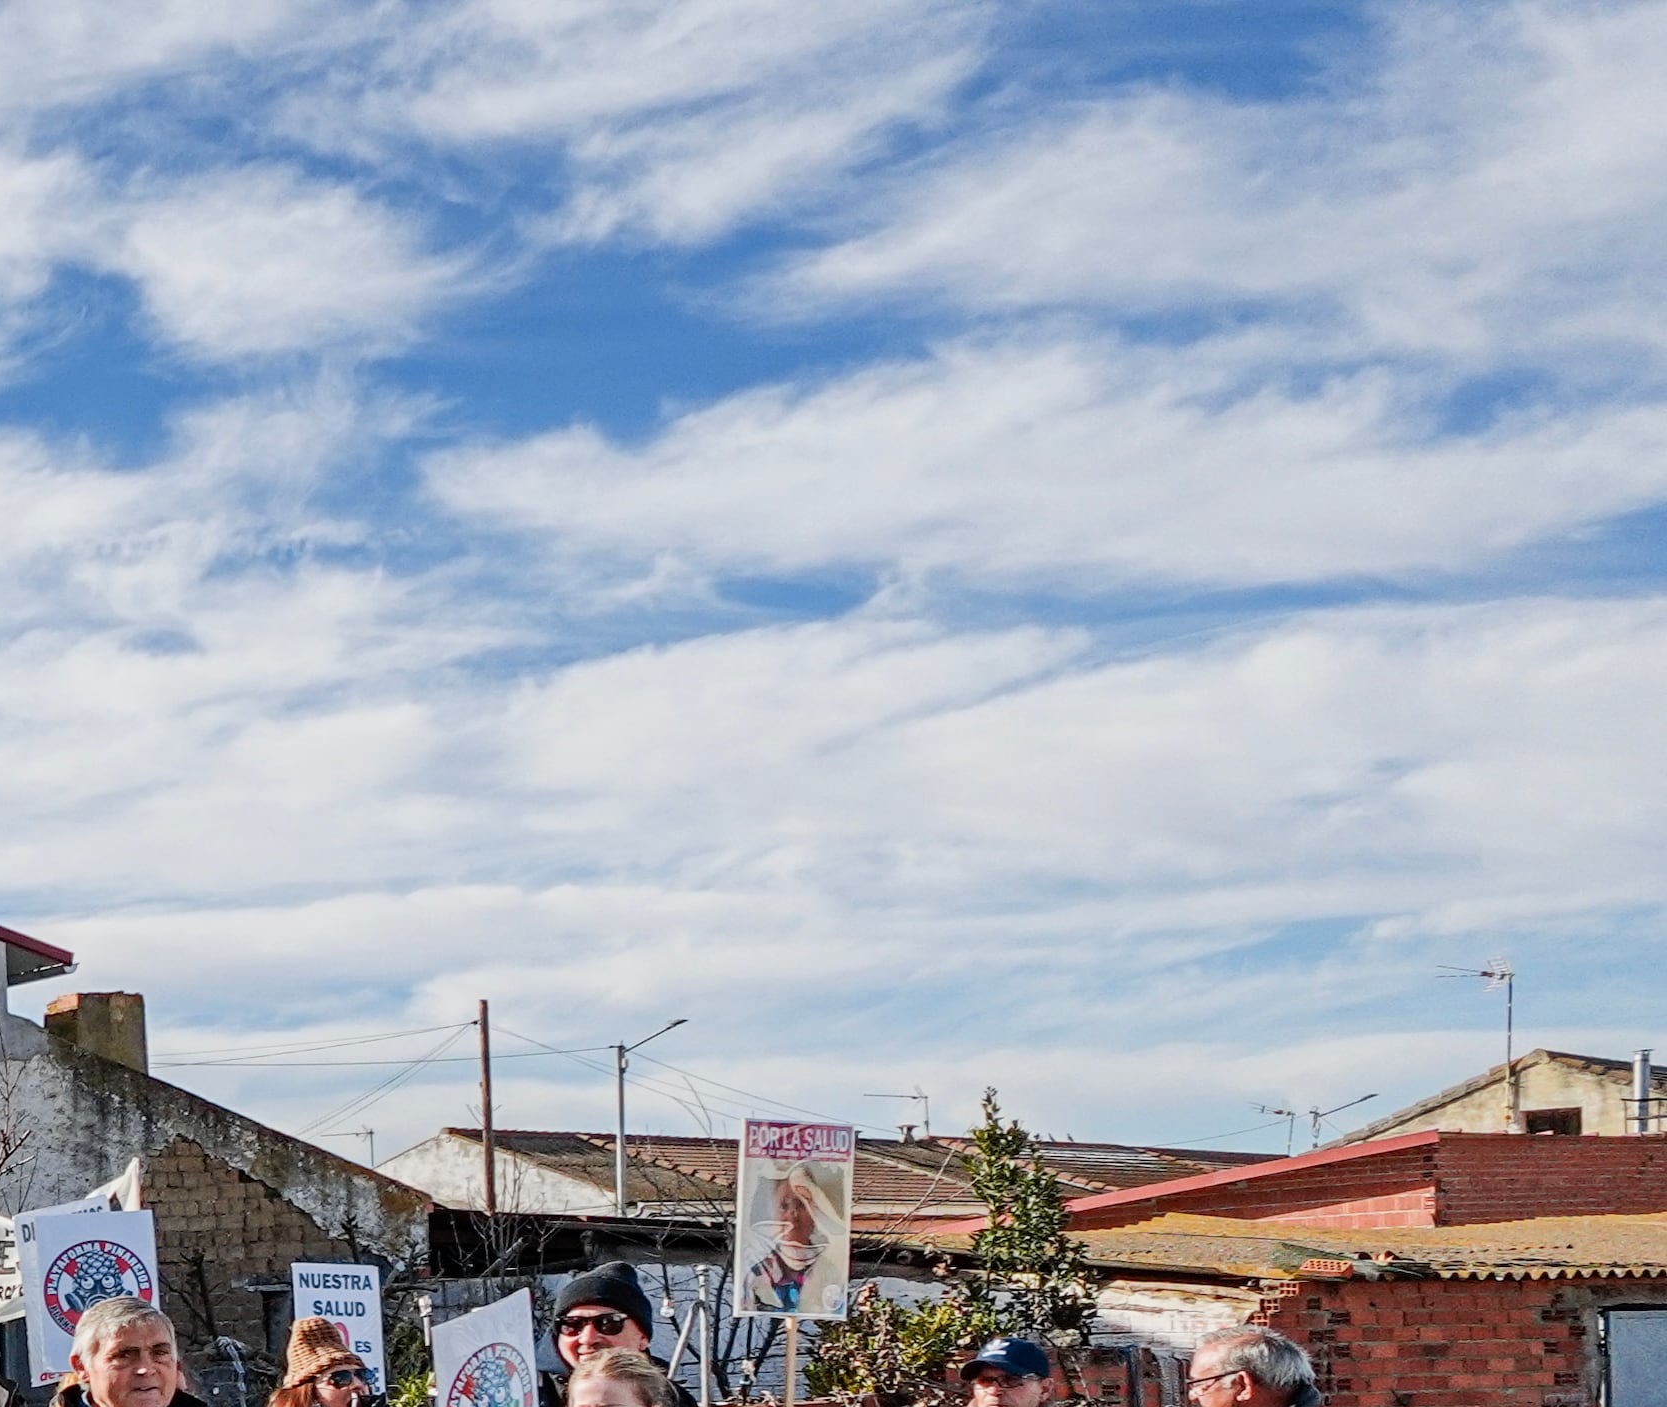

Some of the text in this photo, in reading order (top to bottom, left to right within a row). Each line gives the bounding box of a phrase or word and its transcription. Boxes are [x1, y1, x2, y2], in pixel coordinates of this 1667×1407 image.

[749, 1125, 780, 1148] POR
[782, 1127, 801, 1149] LA
[803, 1128, 850, 1152] SALUD
[299, 1272, 373, 1290] NUESTRA
[312, 1300, 366, 1317] SALUD
[354, 1341, 372, 1353] ES
